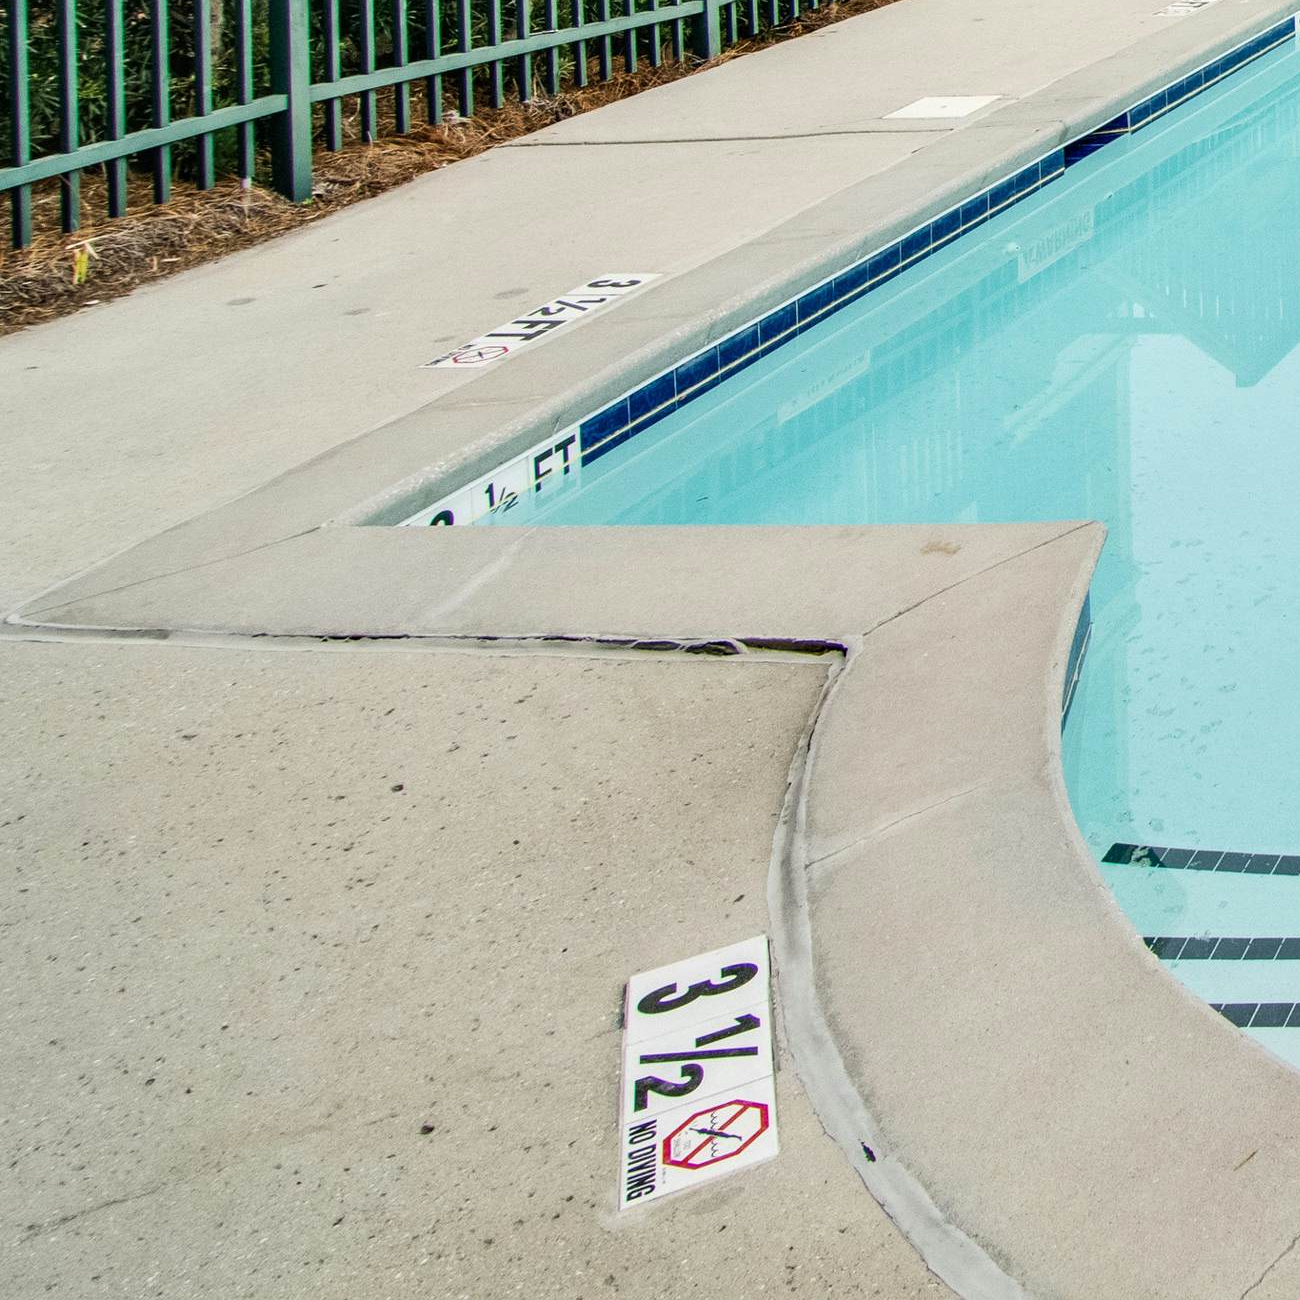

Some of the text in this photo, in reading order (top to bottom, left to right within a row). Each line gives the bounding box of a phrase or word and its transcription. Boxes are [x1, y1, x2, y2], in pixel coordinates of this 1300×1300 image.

[485, 320, 567, 341] FT
[534, 434, 576, 493] FT
[637, 962, 759, 1014] 3
[626, 1119, 657, 1202] NO DIVING
